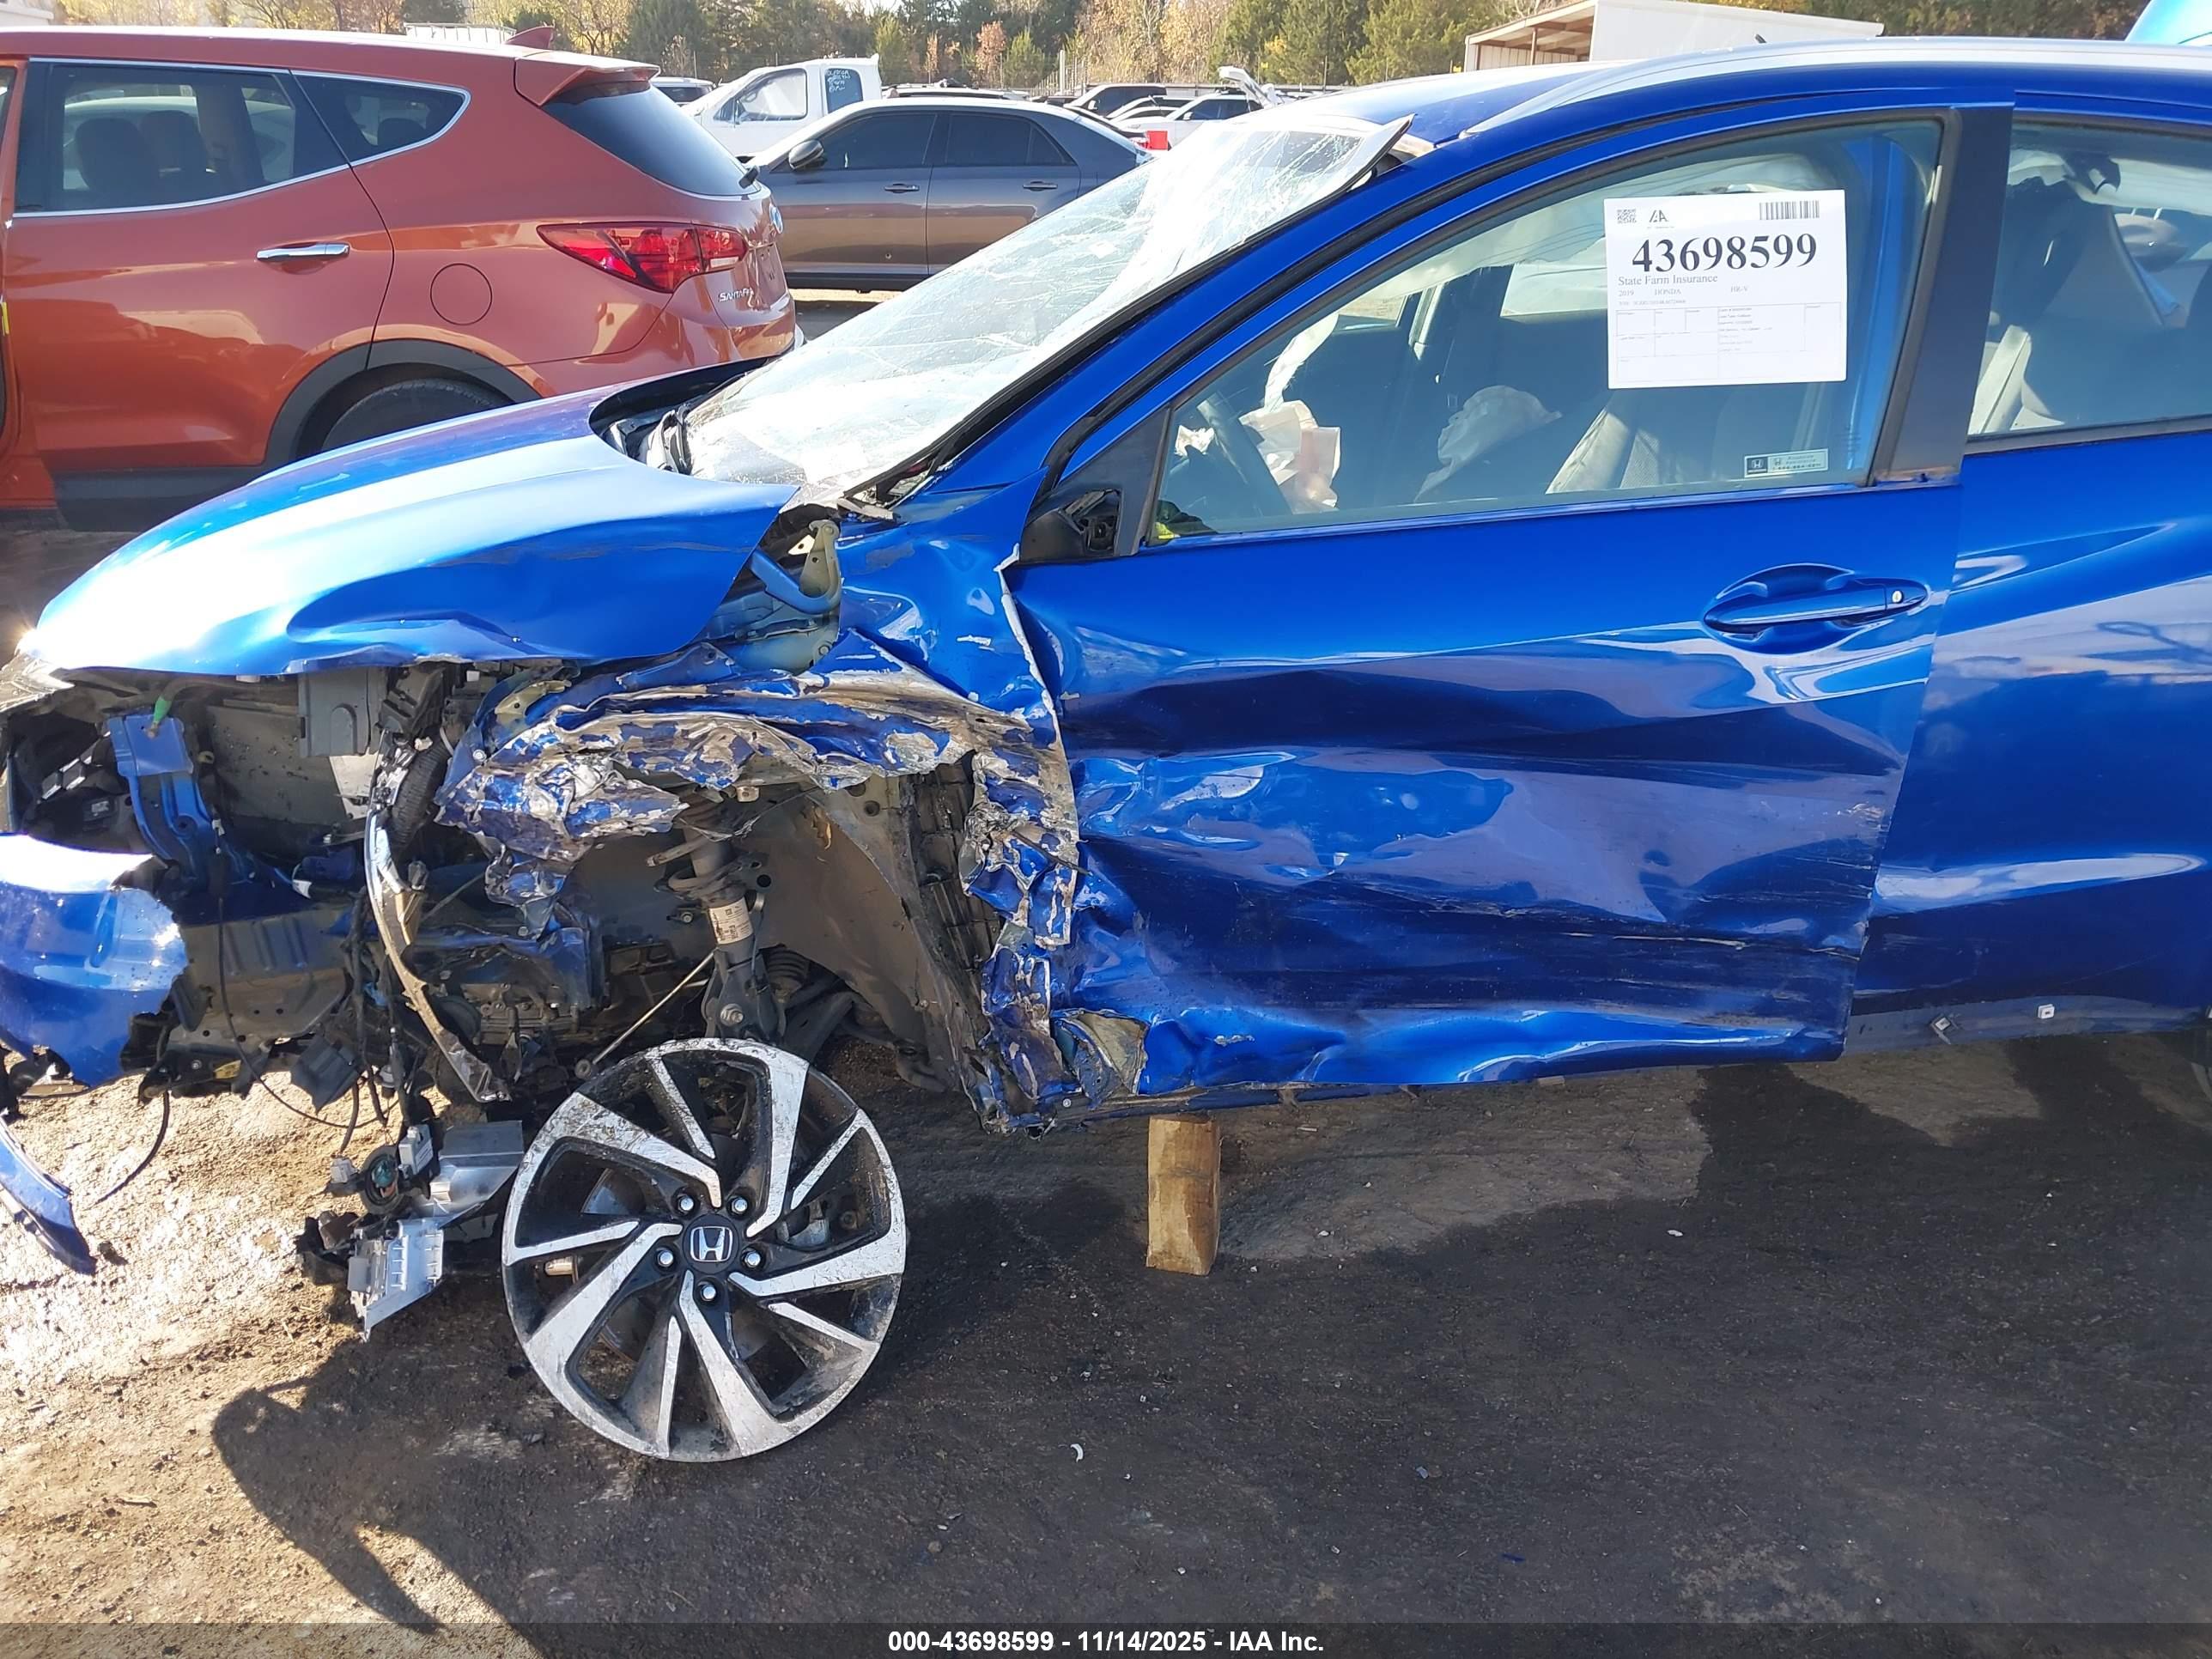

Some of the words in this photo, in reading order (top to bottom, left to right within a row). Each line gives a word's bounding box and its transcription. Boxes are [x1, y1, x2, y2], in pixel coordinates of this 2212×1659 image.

[1632, 233, 1817, 272] 43698599
[1618, 276, 1642, 286] State
[1644, 275, 1670, 285] Farm
[1672, 274, 1718, 284] Insurance
